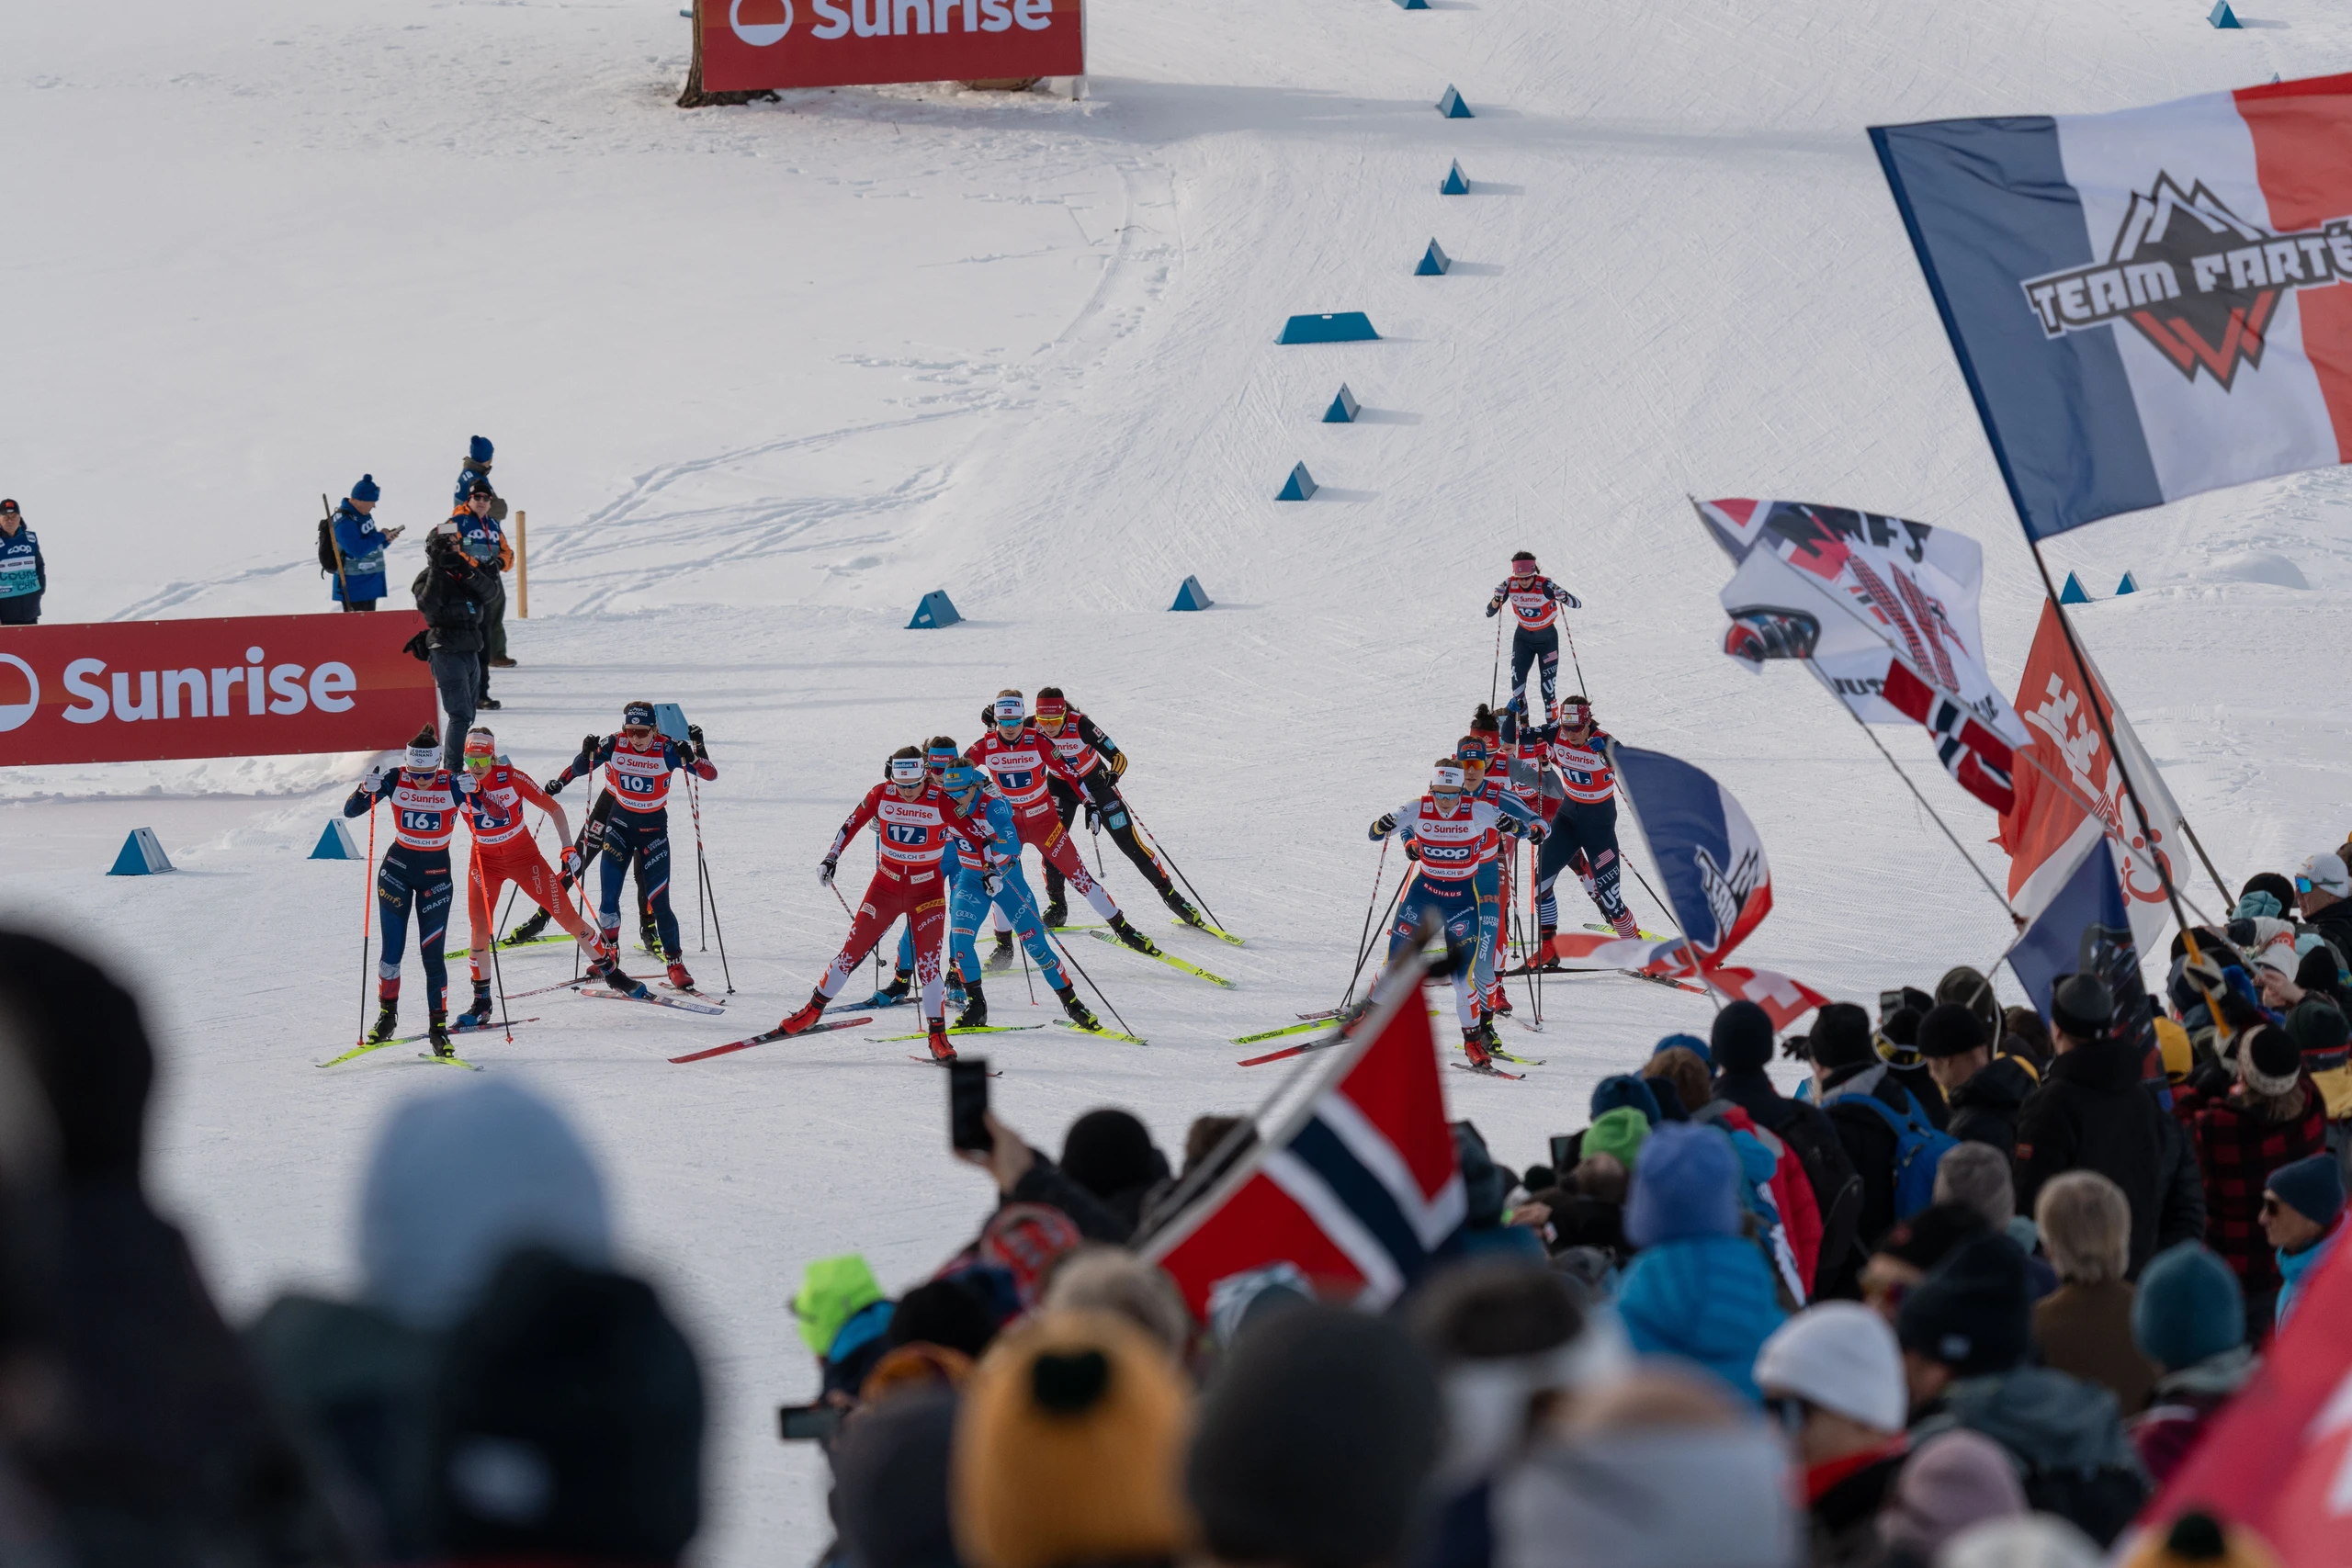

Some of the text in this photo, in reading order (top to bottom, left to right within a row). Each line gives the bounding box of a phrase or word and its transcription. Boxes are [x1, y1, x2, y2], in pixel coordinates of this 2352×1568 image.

[810, 0, 1053, 39] Sunrise
[2031, 260, 2181, 329] TEAM
[1518, 607, 1533, 616] 19
[61, 646, 357, 724] Sunrise
[627, 758, 659, 770] Sunrise
[1001, 755, 1035, 764] Sunrise
[1565, 752, 1595, 765] Sunrise
[620, 775, 643, 789] 10
[1006, 773, 1016, 787] 1
[1563, 768, 1580, 784] 11
[411, 794, 446, 804] Sunrise
[622, 797, 646, 807] GOMS.CH
[896, 807, 933, 819] Sunrise
[404, 812, 439, 829] 16 2
[481, 815, 495, 828] 6
[889, 826, 915, 842] 17
[1433, 824, 1469, 833] Sunrise
[404, 837, 431, 845] GOMS.CH
[958, 839, 972, 852] 8
[1051, 835, 1068, 858] CRAFT
[888, 851, 917, 860] GOMS.CH
[1423, 846, 1470, 859] coop
[644, 852, 664, 870] CRAFT
[962, 857, 981, 865] GOMS.C
[912, 872, 933, 882] Scandic
[548, 874, 560, 914] RAIFFEISEN
[1423, 883, 1462, 897] BAUHAUS
[423, 898, 446, 914] CRAFT
[917, 914, 940, 931] CRAFT
[1203, 973, 1232, 988] FISCHER
[1247, 1029, 1284, 1043] FISCHER
